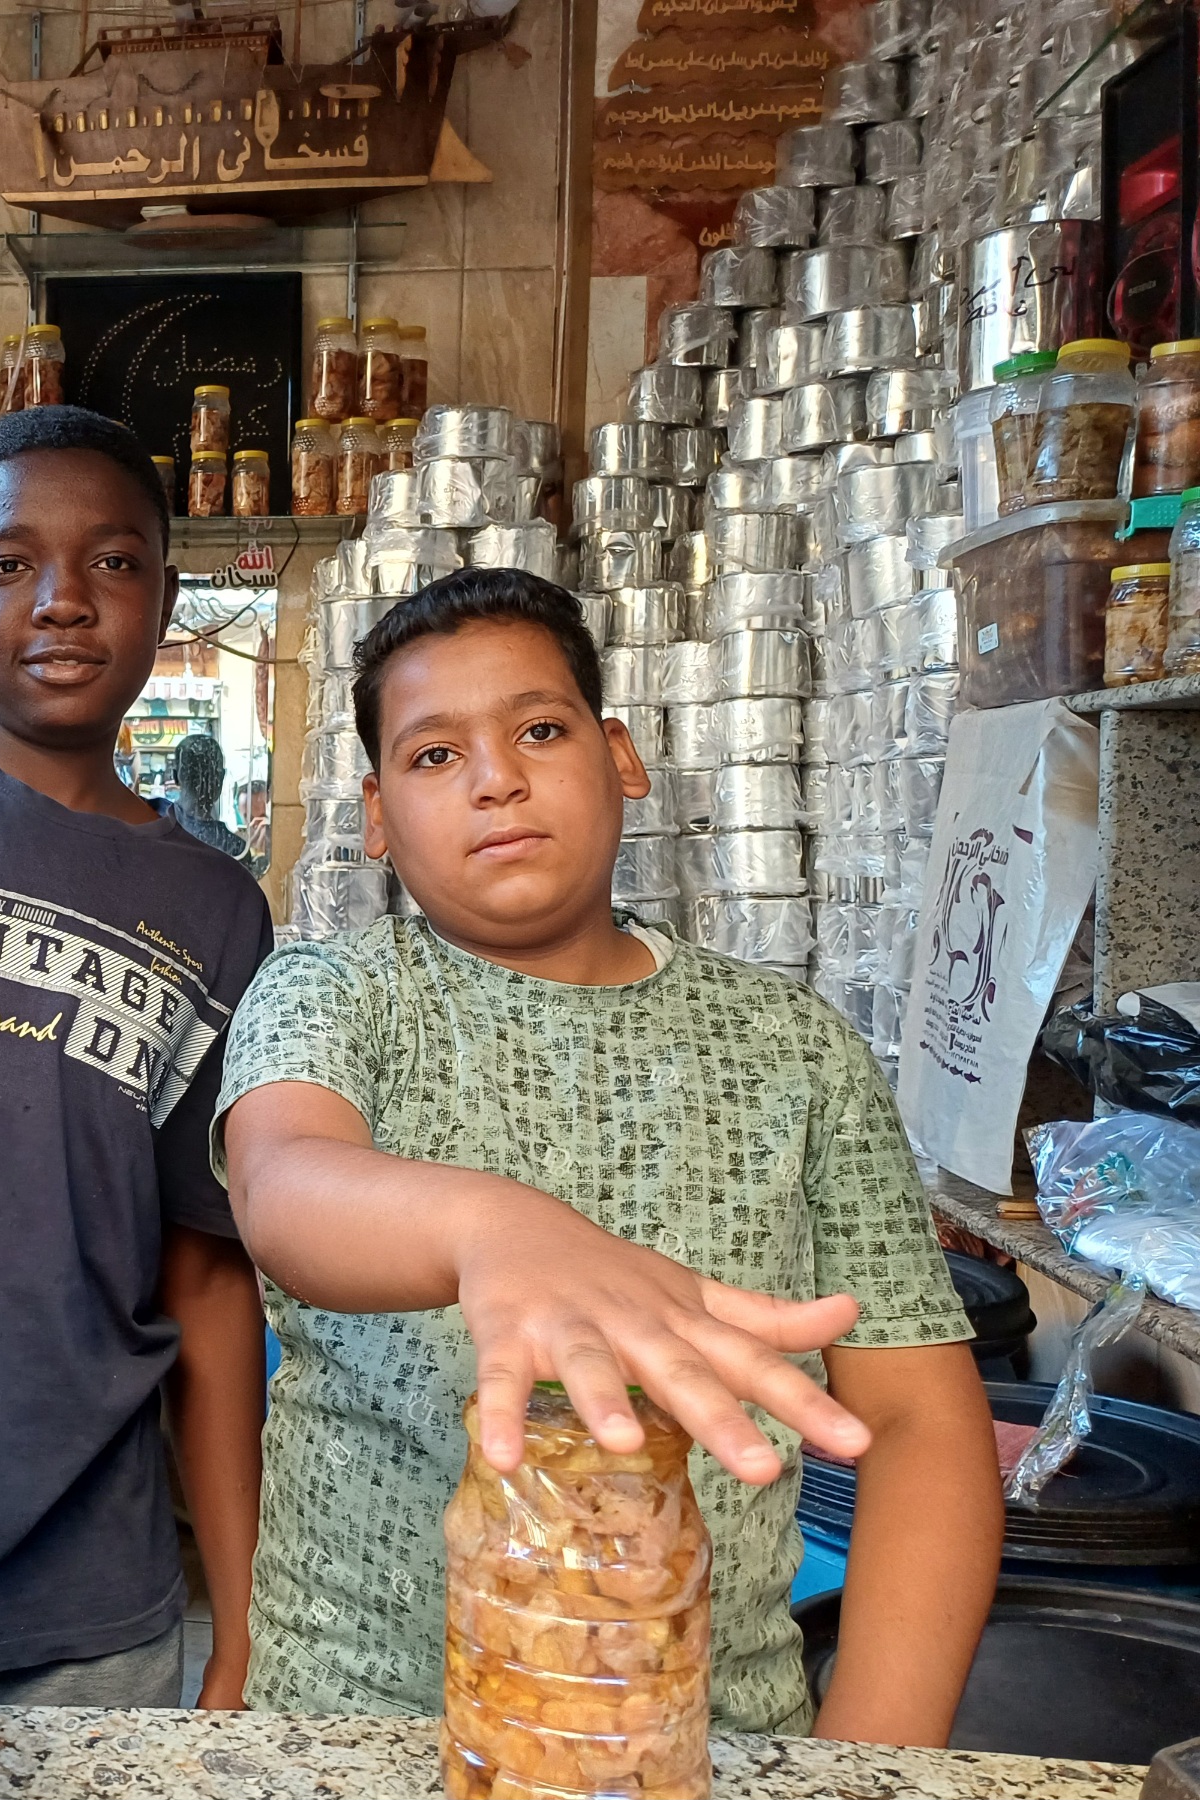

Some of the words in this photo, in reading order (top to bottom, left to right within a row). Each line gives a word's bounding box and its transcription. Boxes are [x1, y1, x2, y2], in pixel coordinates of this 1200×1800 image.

[52, 130, 201, 187] الرحمن
[237, 546, 273, 570] الله
[211, 566, 277, 594] سبحان
[135, 920, 181, 956] Authentic
